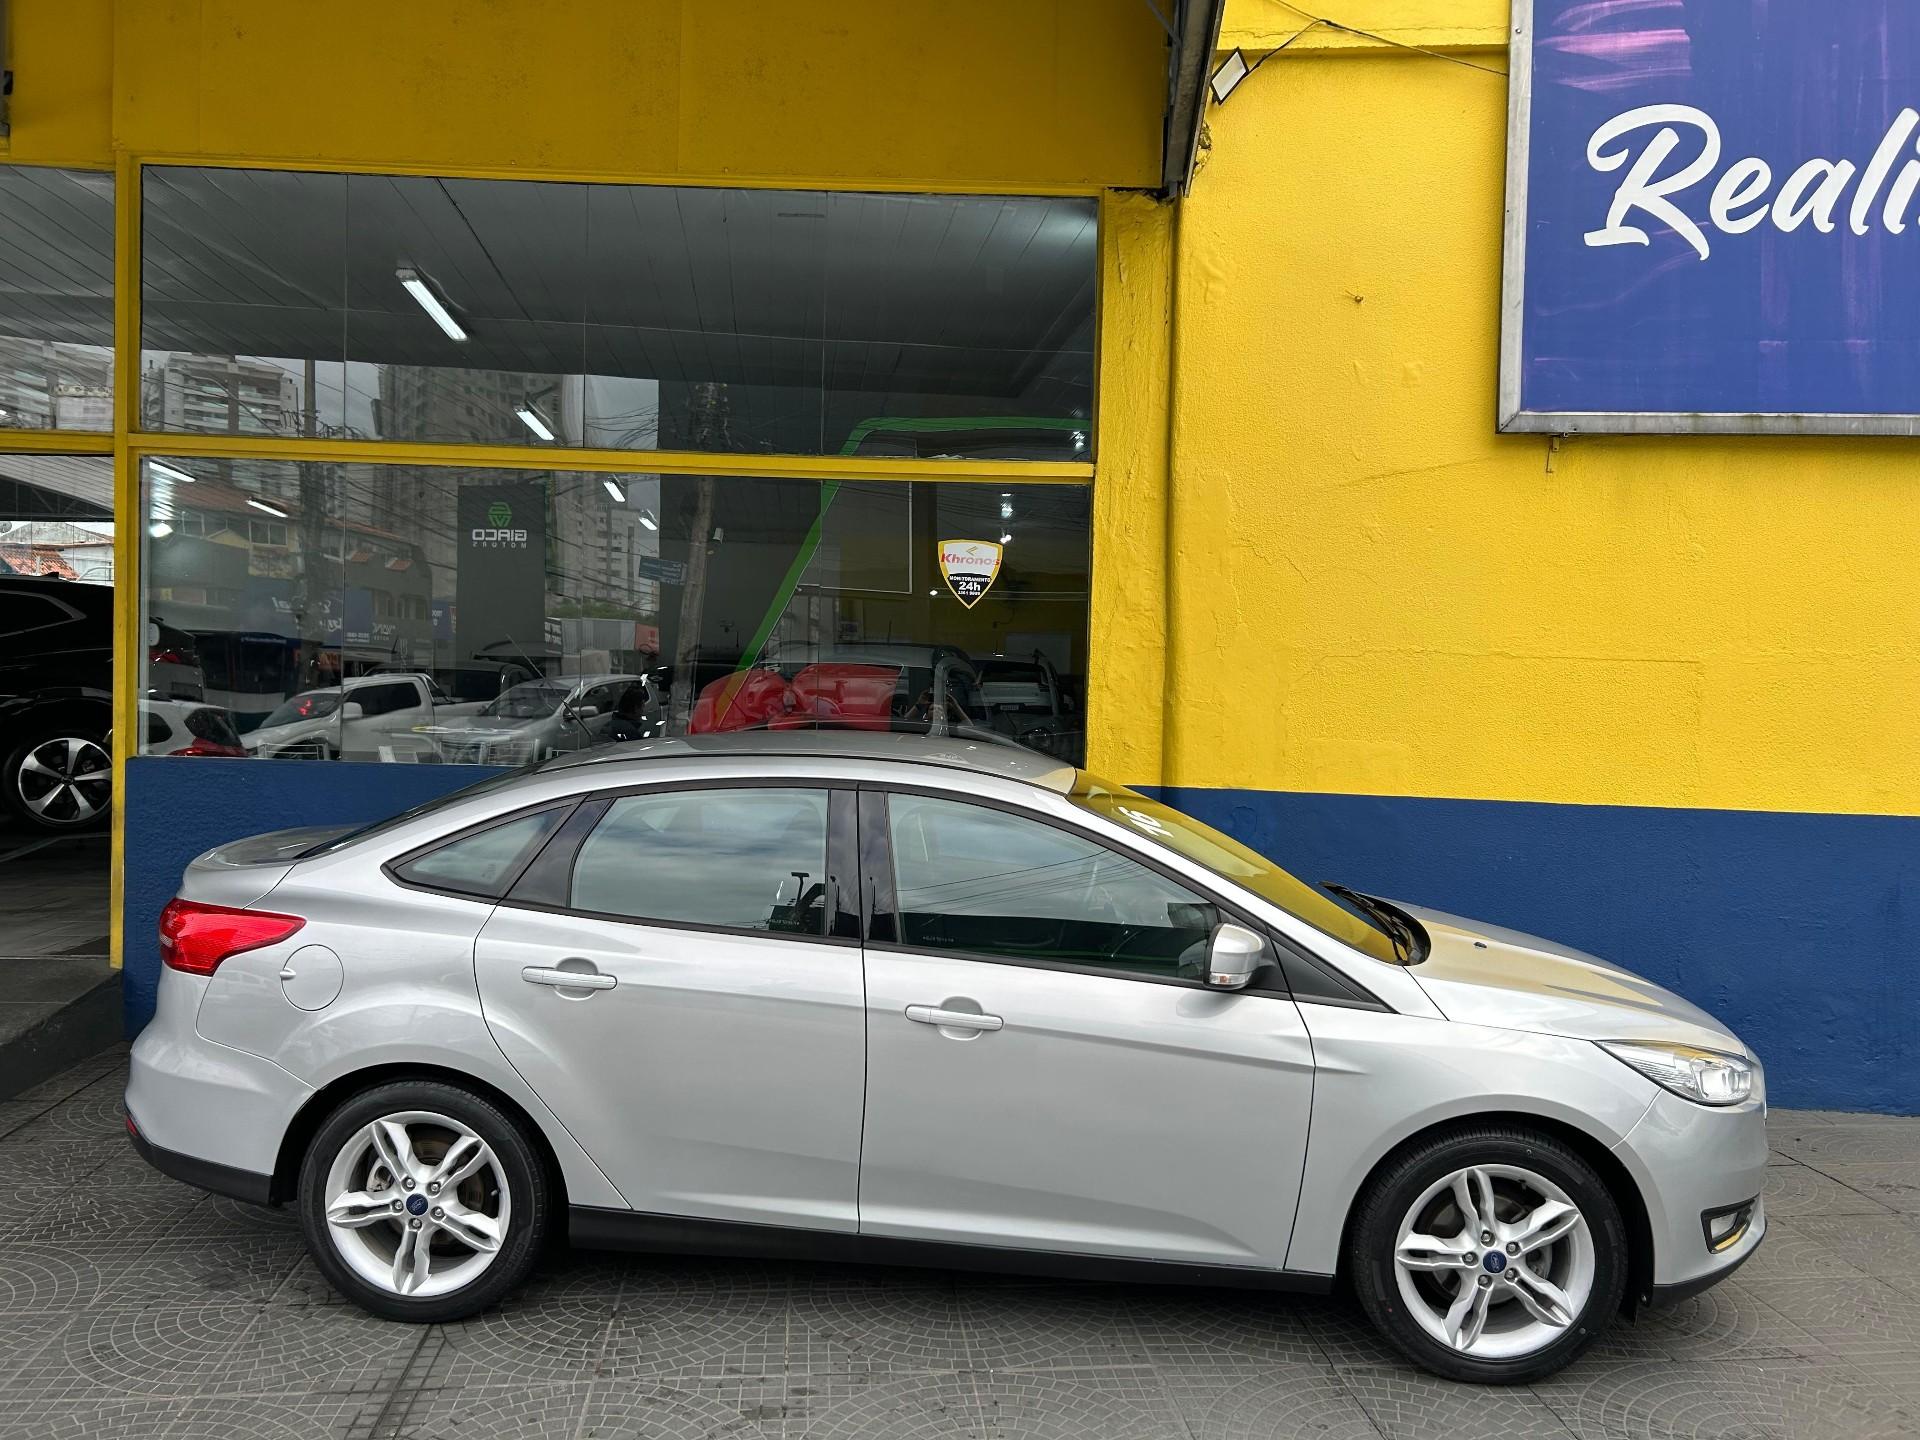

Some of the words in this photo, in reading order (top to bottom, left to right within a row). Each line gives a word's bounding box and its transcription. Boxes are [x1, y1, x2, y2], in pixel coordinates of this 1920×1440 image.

[1583, 103, 1920, 261] Reali
[941, 553, 1000, 566] Khronos
[958, 581, 981, 591] 24h
[1117, 806, 1175, 838] 16
